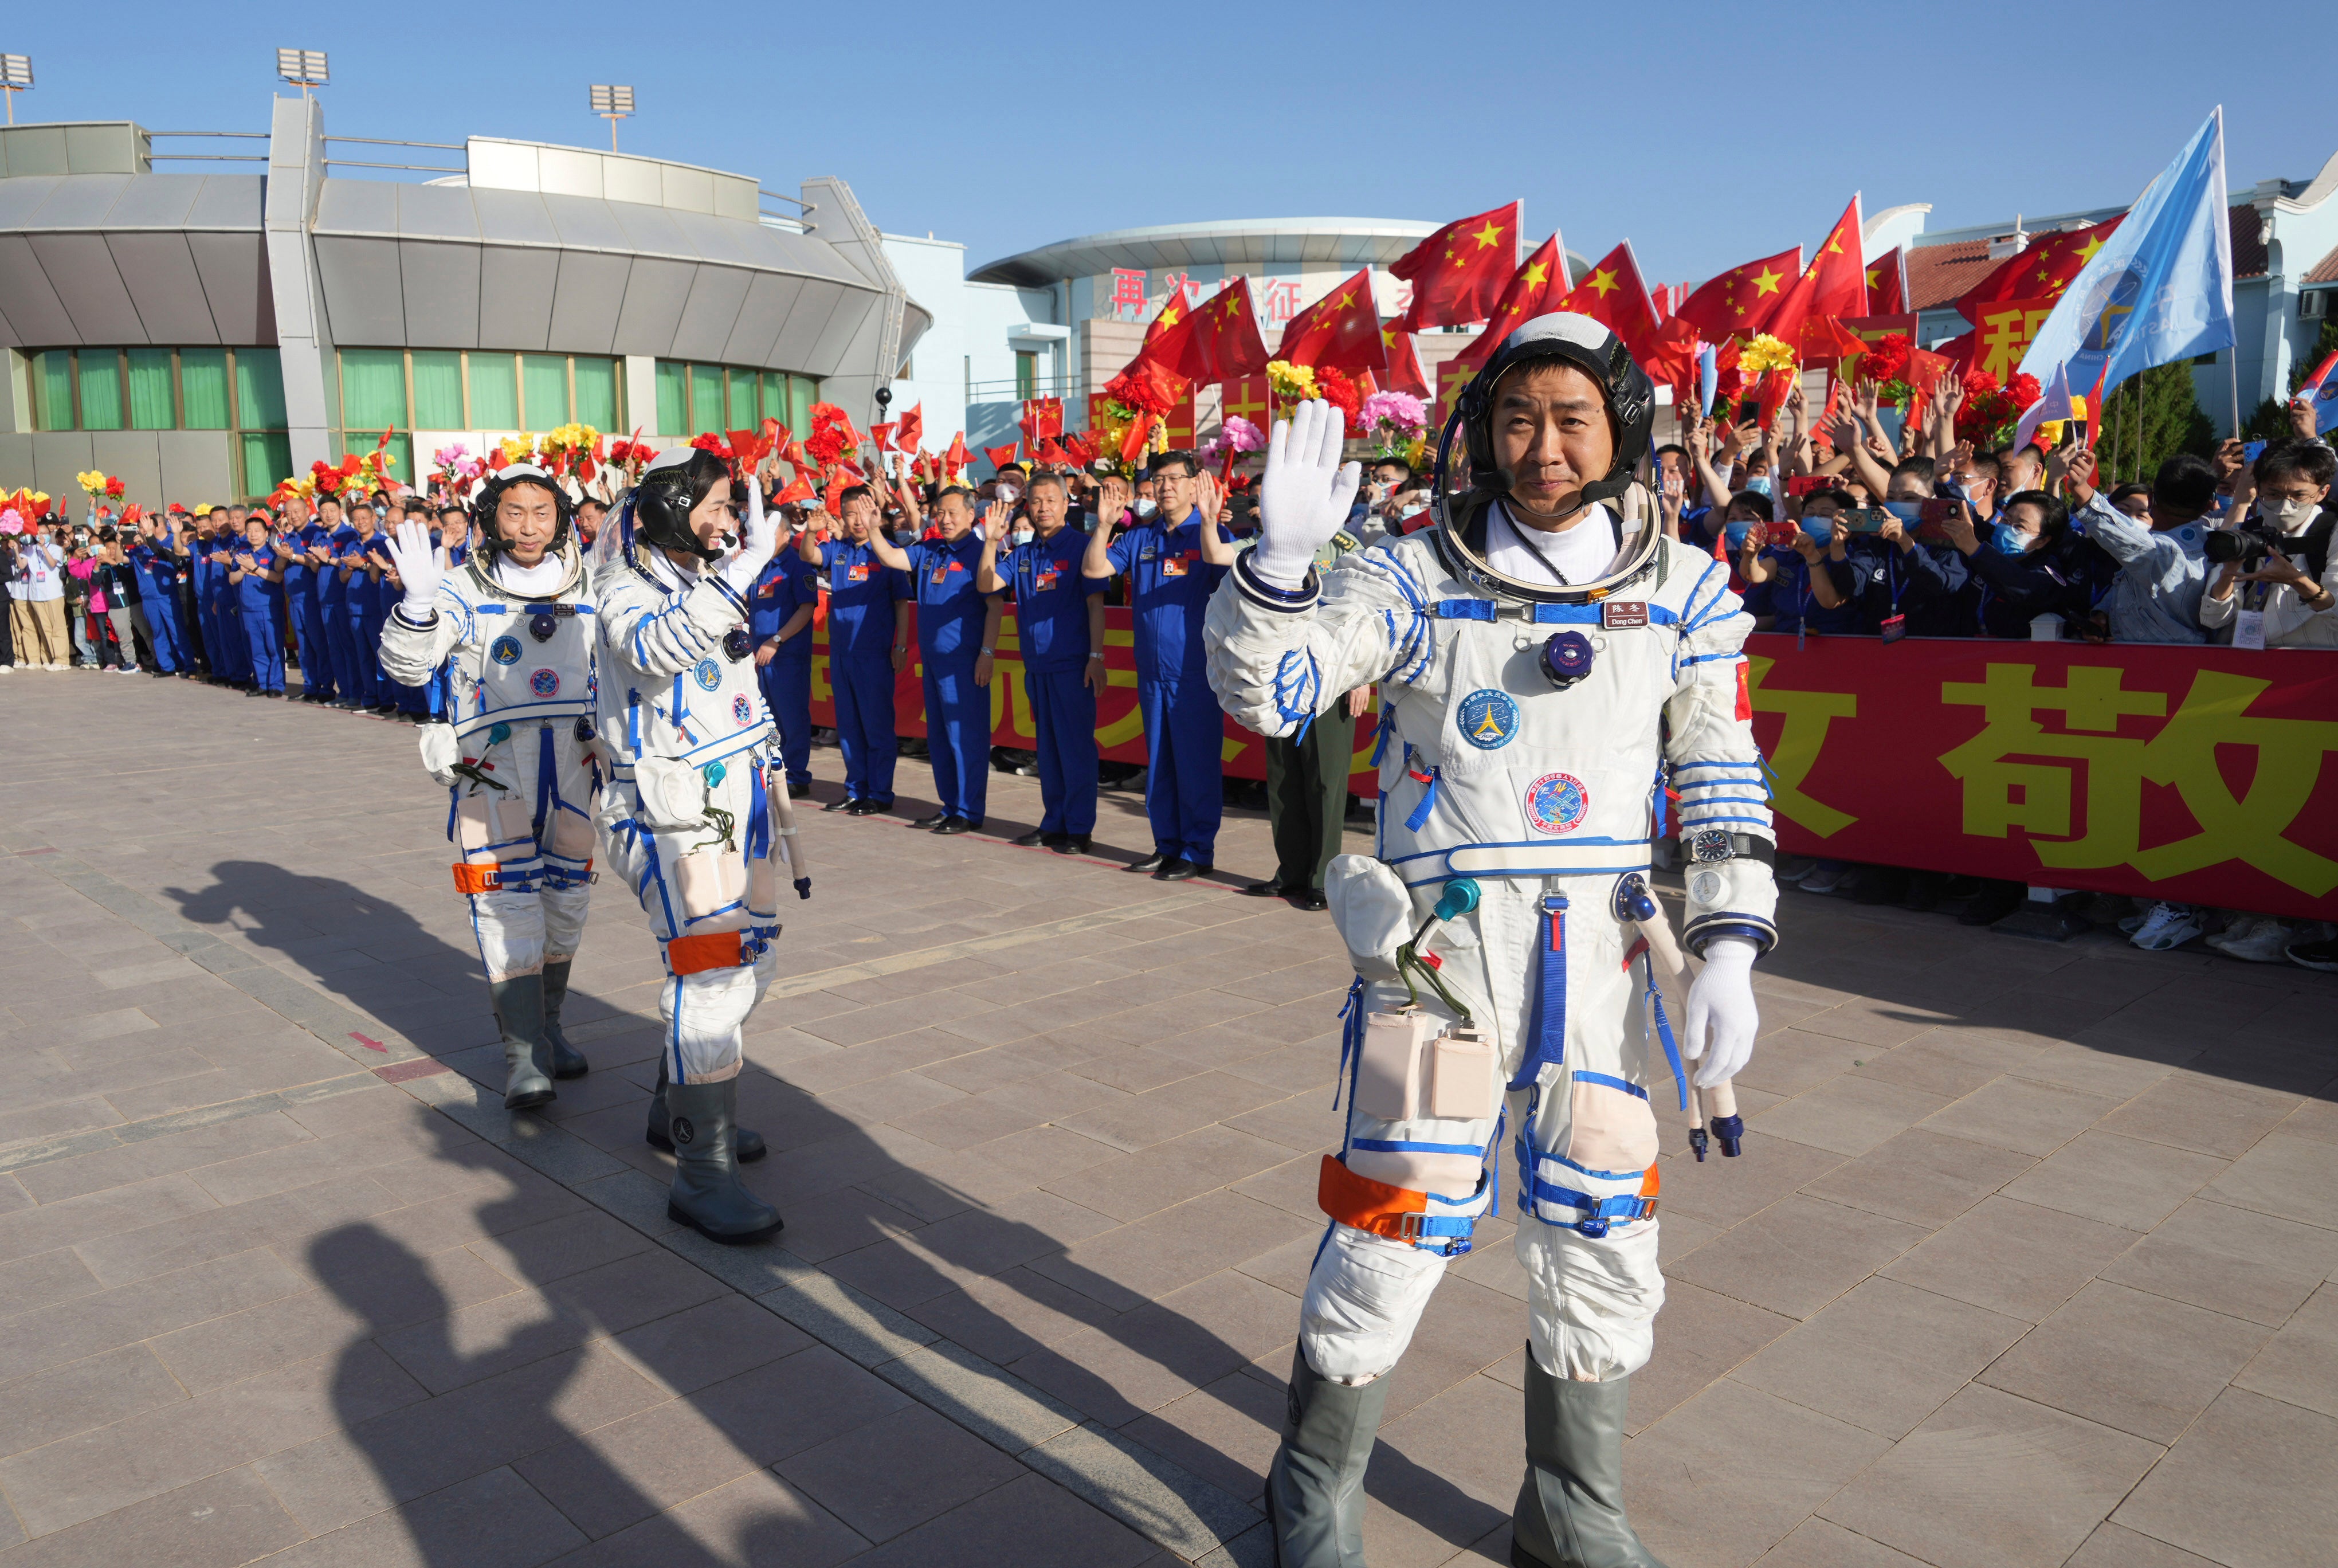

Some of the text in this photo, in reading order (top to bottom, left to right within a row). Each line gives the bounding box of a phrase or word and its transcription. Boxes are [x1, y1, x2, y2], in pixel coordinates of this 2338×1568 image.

[1111, 267, 1302, 322] 再次征
[1612, 603, 1640, 613] 陈冬
